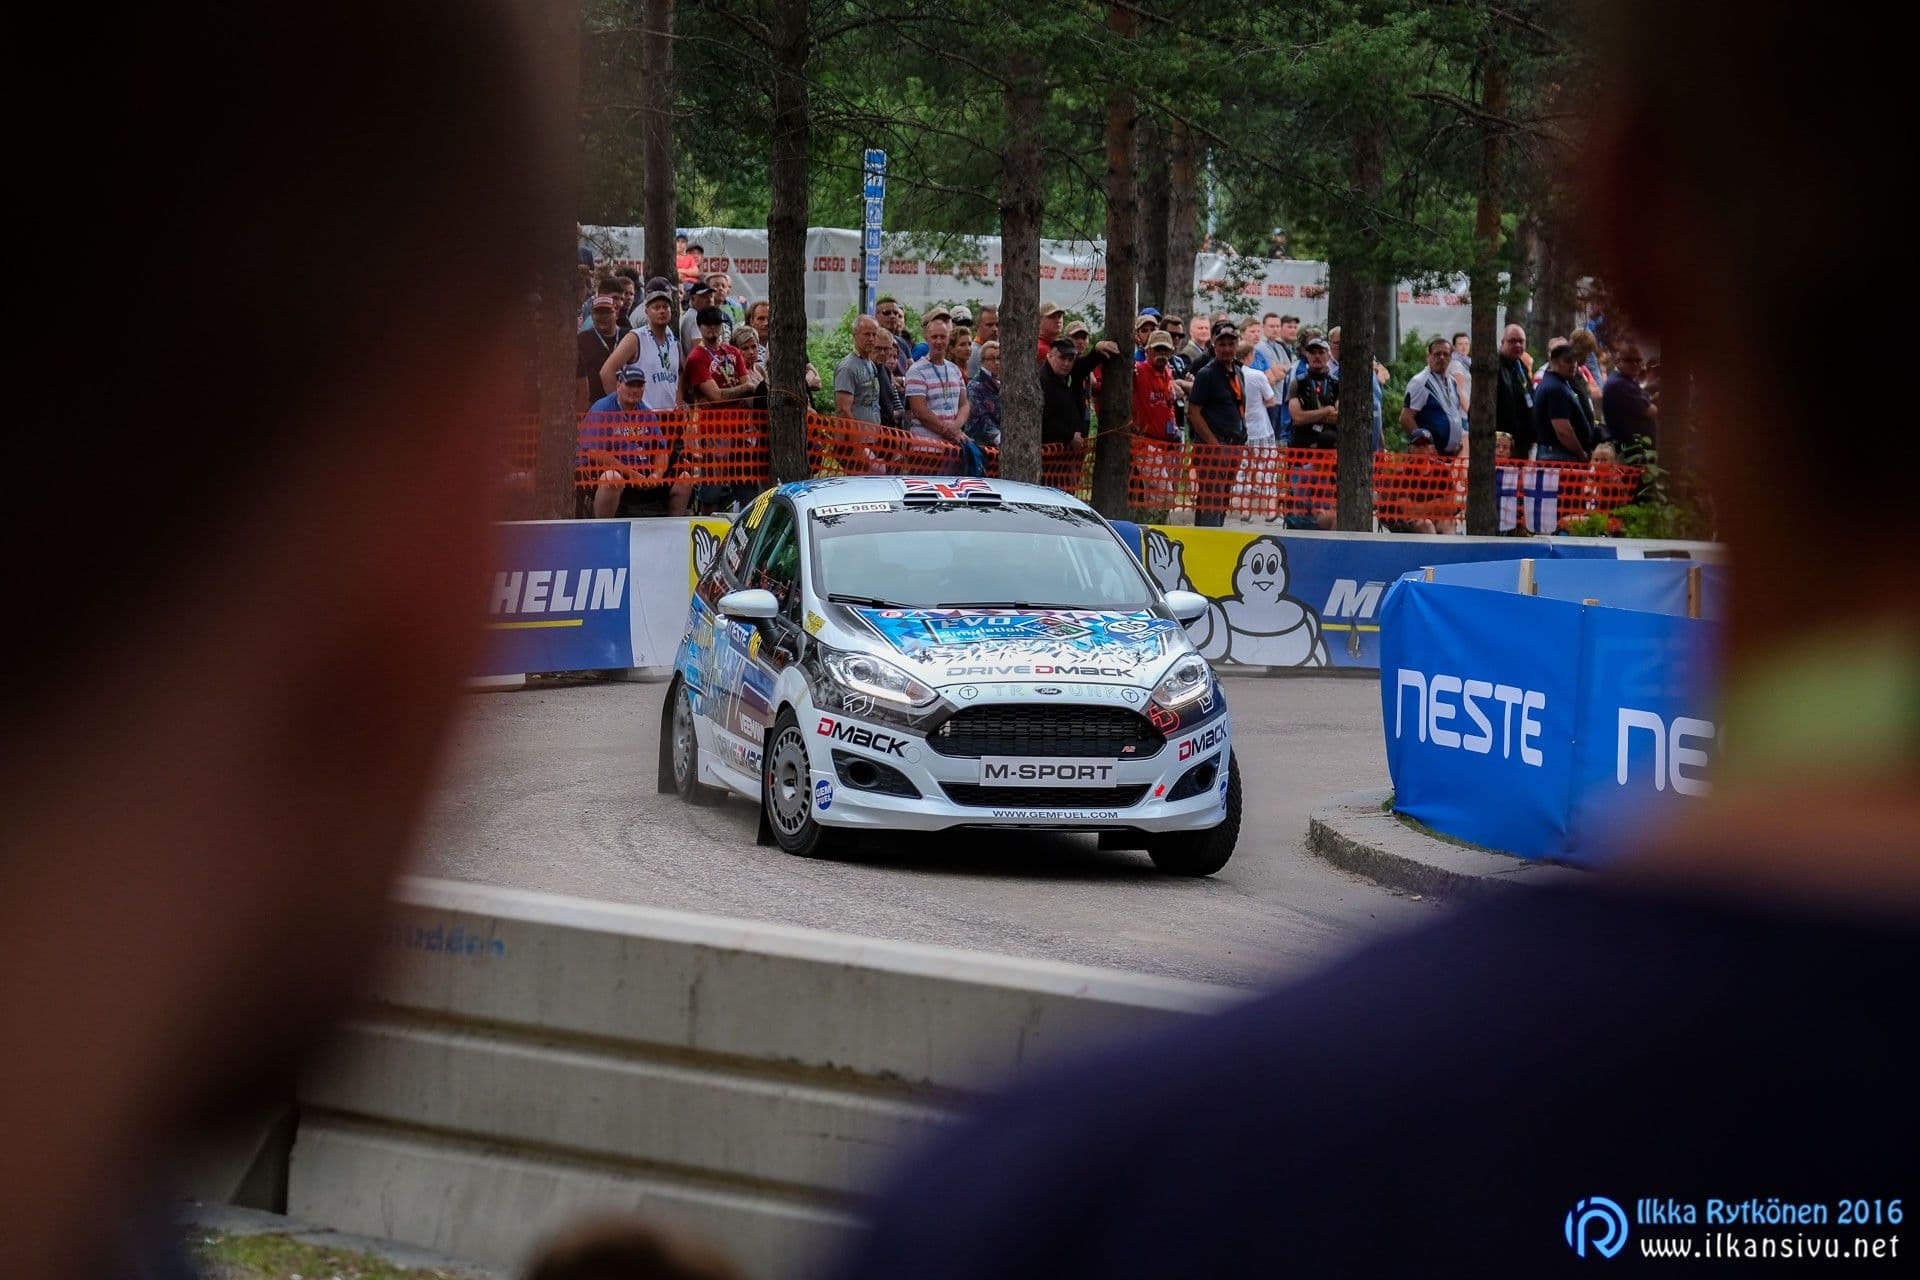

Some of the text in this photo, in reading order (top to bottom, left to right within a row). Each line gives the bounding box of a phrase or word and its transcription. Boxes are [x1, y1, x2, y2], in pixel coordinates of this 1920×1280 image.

[821, 504, 887, 515] HL-9859
[941, 616, 1010, 629] EVO
[1396, 668, 1546, 768] NESTE
[985, 764, 1113, 780] M-SPORT
[816, 786, 832, 797] GEM
[816, 795, 832, 805] FUEL
[992, 810, 1119, 819] WWW.GEMFUEL.COM
